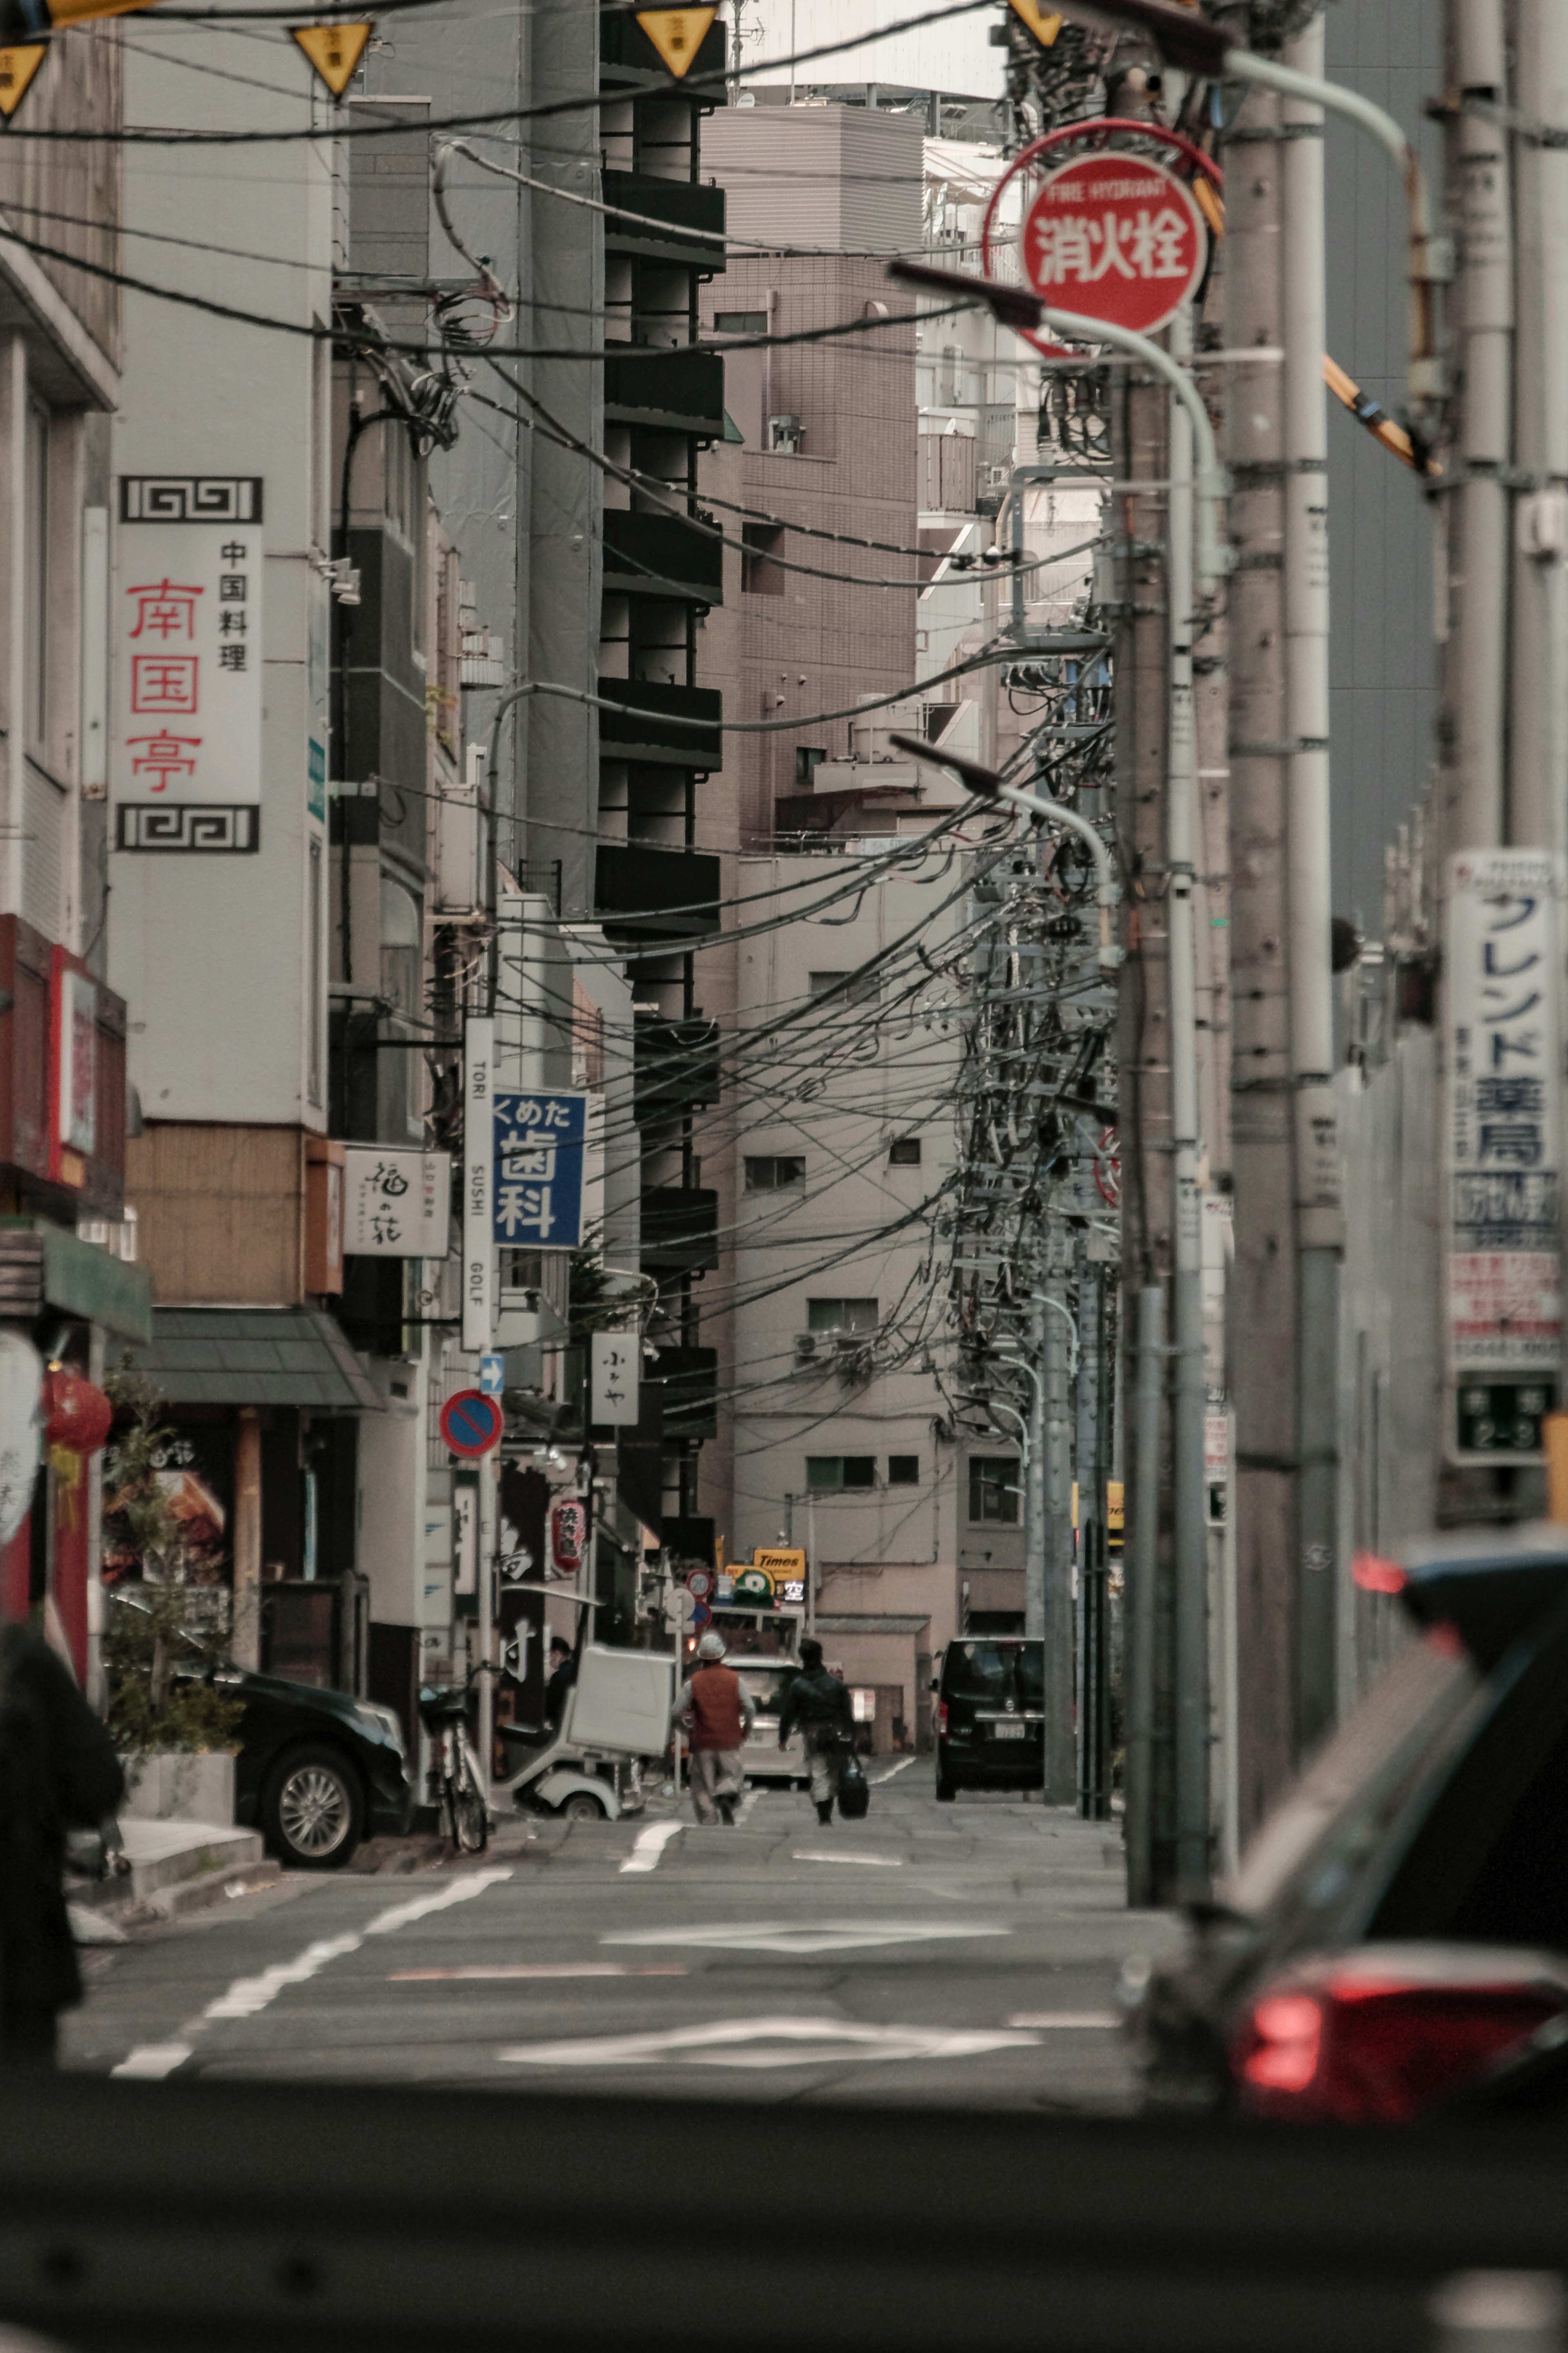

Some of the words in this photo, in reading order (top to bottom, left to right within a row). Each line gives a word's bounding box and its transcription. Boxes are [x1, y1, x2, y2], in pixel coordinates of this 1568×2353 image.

[1034, 209, 1188, 285] 消火栓
[219, 540, 248, 671] 中国料理
[126, 578, 204, 793] 南国亭
[472, 1062, 486, 1099] TORI
[493, 1100, 570, 1126] くめた
[471, 1165, 485, 1216] SUSHI
[496, 1130, 557, 1238] 歯科
[470, 1262, 483, 1306] GOLF
[760, 1555, 799, 1566] Times
